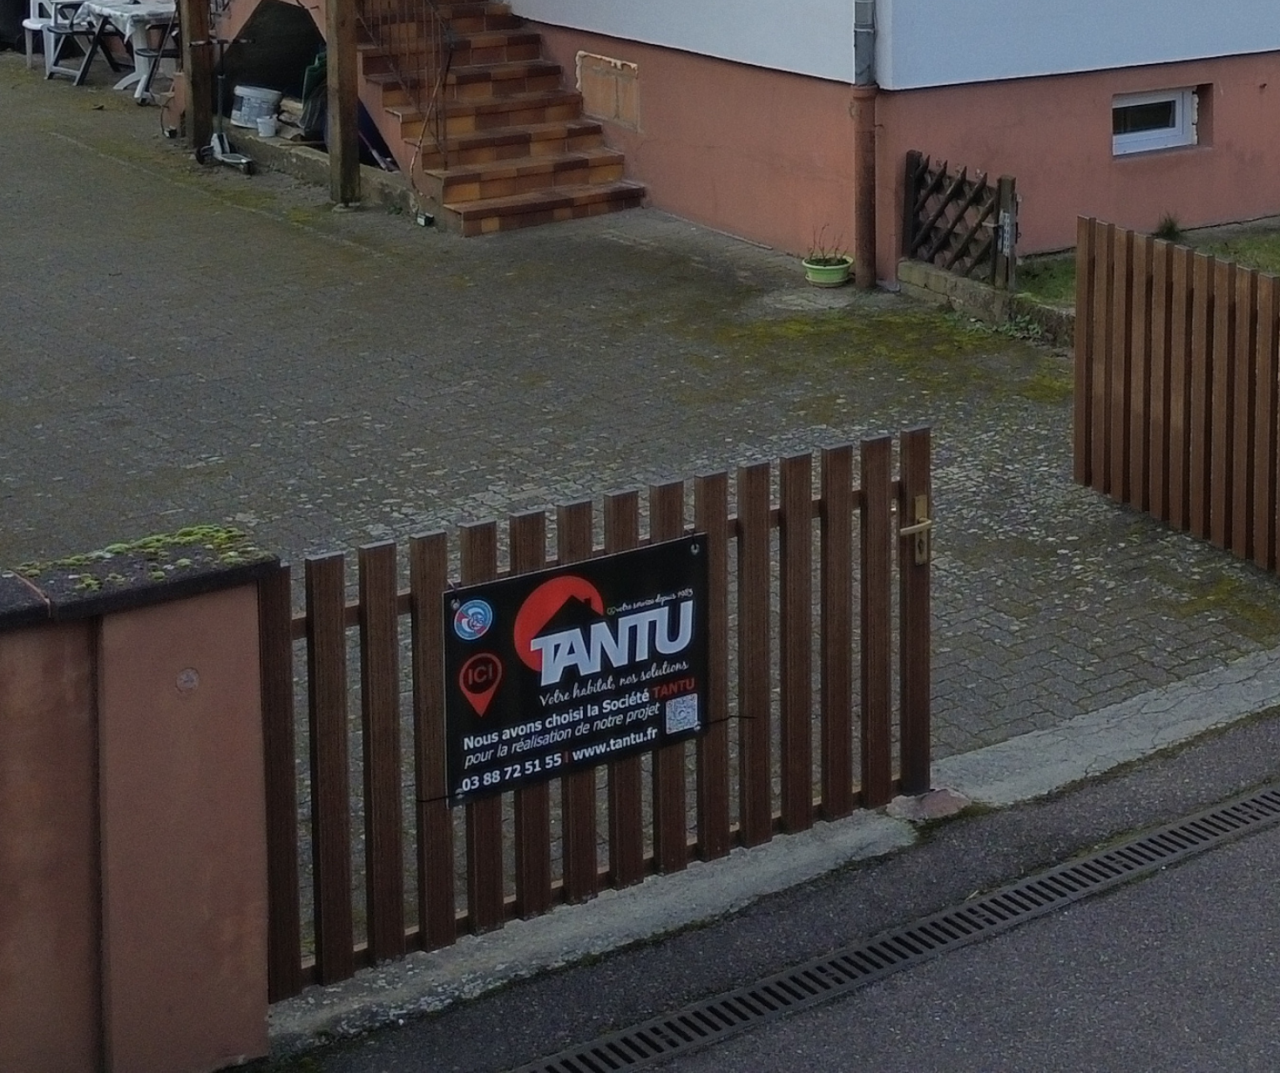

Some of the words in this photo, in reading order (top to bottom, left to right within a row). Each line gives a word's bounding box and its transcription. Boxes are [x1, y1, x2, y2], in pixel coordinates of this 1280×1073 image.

[468, 664, 493, 685] ICI
[530, 600, 693, 687] TANTU
[464, 733, 499, 751] Nous
[502, 721, 542, 740] avons
[545, 709, 584, 729] choisi
[587, 702, 599, 717] la
[602, 691, 649, 713] Société
[652, 677, 695, 699] TANTU
[539, 691, 570, 707] Votre
[573, 677, 616, 699] habitat,
[620, 672, 638, 687] nos
[640, 660, 689, 682] solutions
[462, 776, 479, 792] 03
[483, 771, 500, 786] 88
[505, 765, 521, 780] 72
[524, 759, 541, 775] 51
[545, 754, 562, 769] 55
[572, 727, 658, 761] www.tantu.fr
[464, 750, 494, 769] pour
[497, 743, 508, 758] la
[511, 729, 572, 754] réalisation
[575, 722, 590, 736] de
[593, 714, 623, 731] notre
[625, 702, 660, 725] projet
